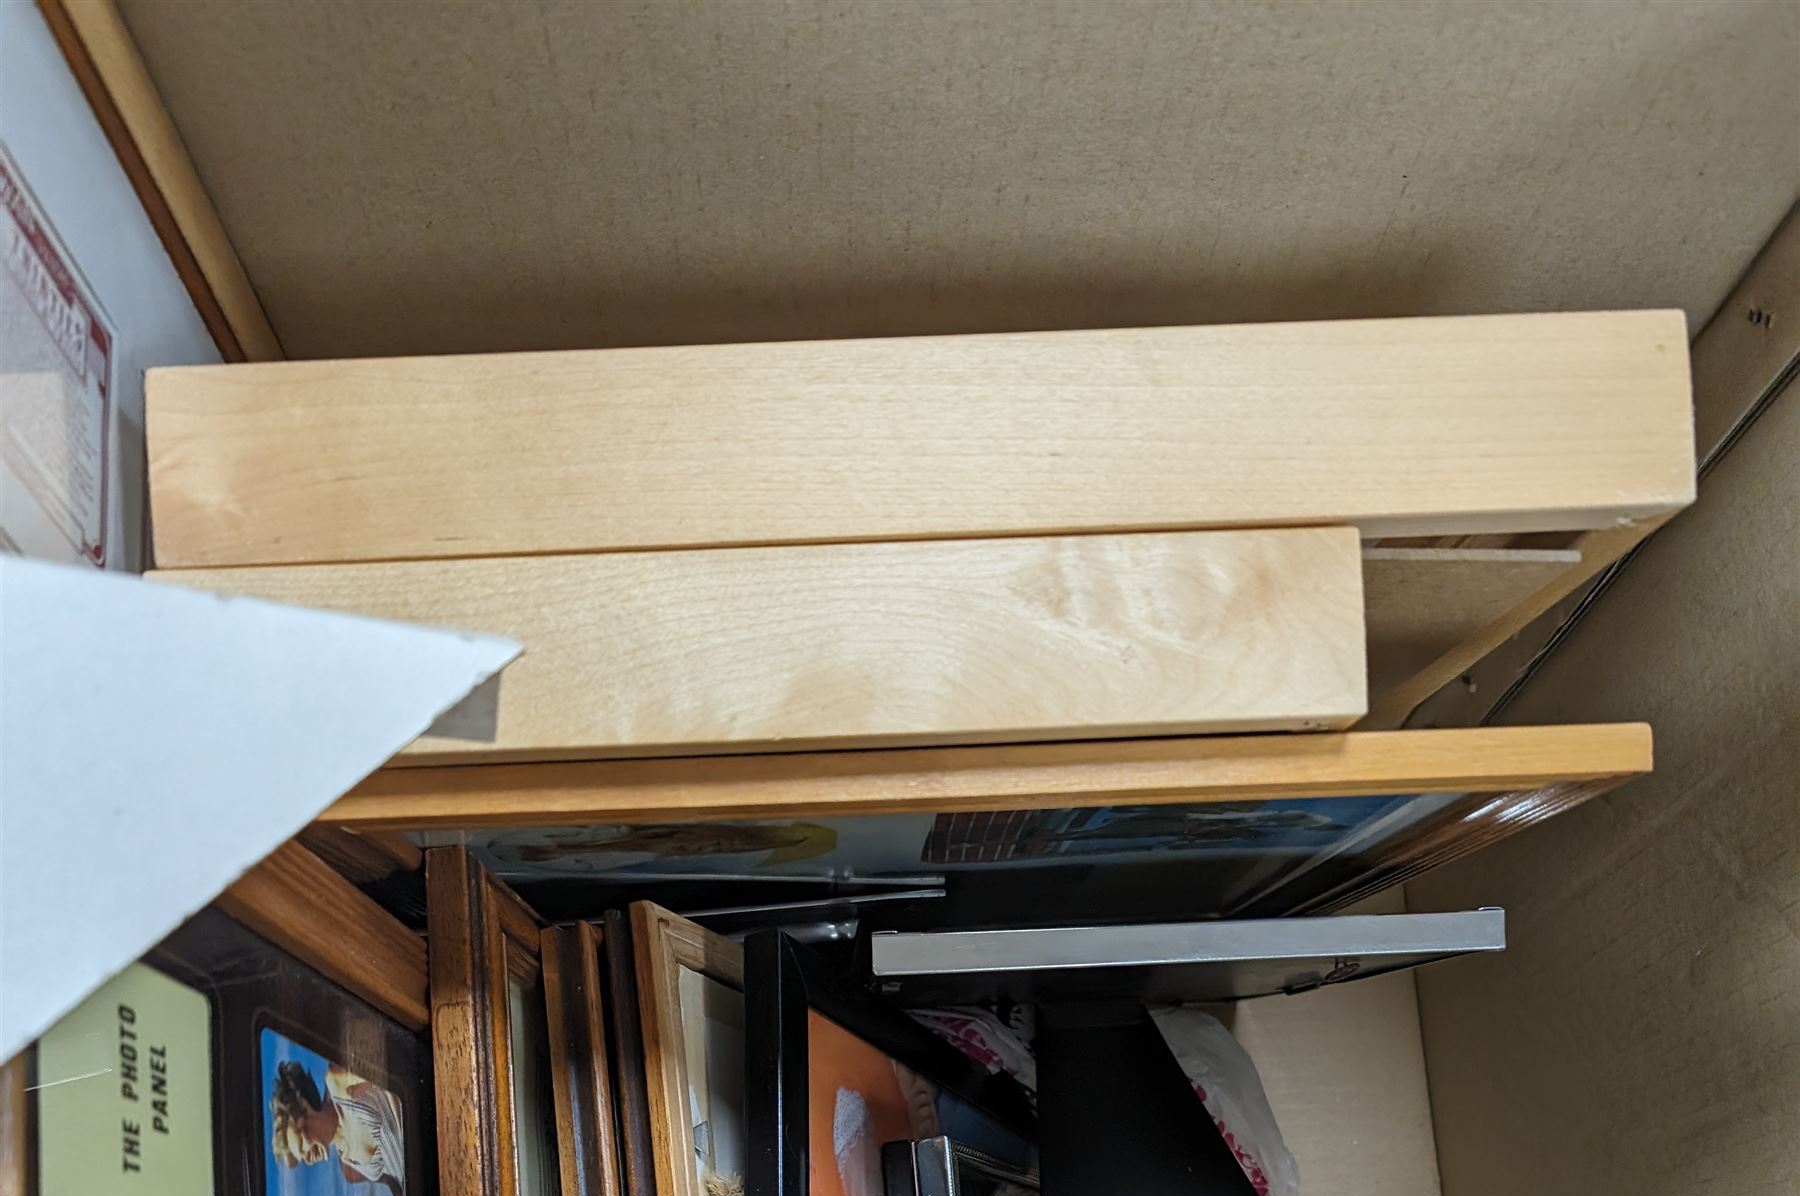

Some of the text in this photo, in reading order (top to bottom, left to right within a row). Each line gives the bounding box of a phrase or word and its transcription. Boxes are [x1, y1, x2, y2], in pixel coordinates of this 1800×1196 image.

[118, 1003, 141, 1174] THE PHOTO
[149, 1044, 170, 1136] PANEL
